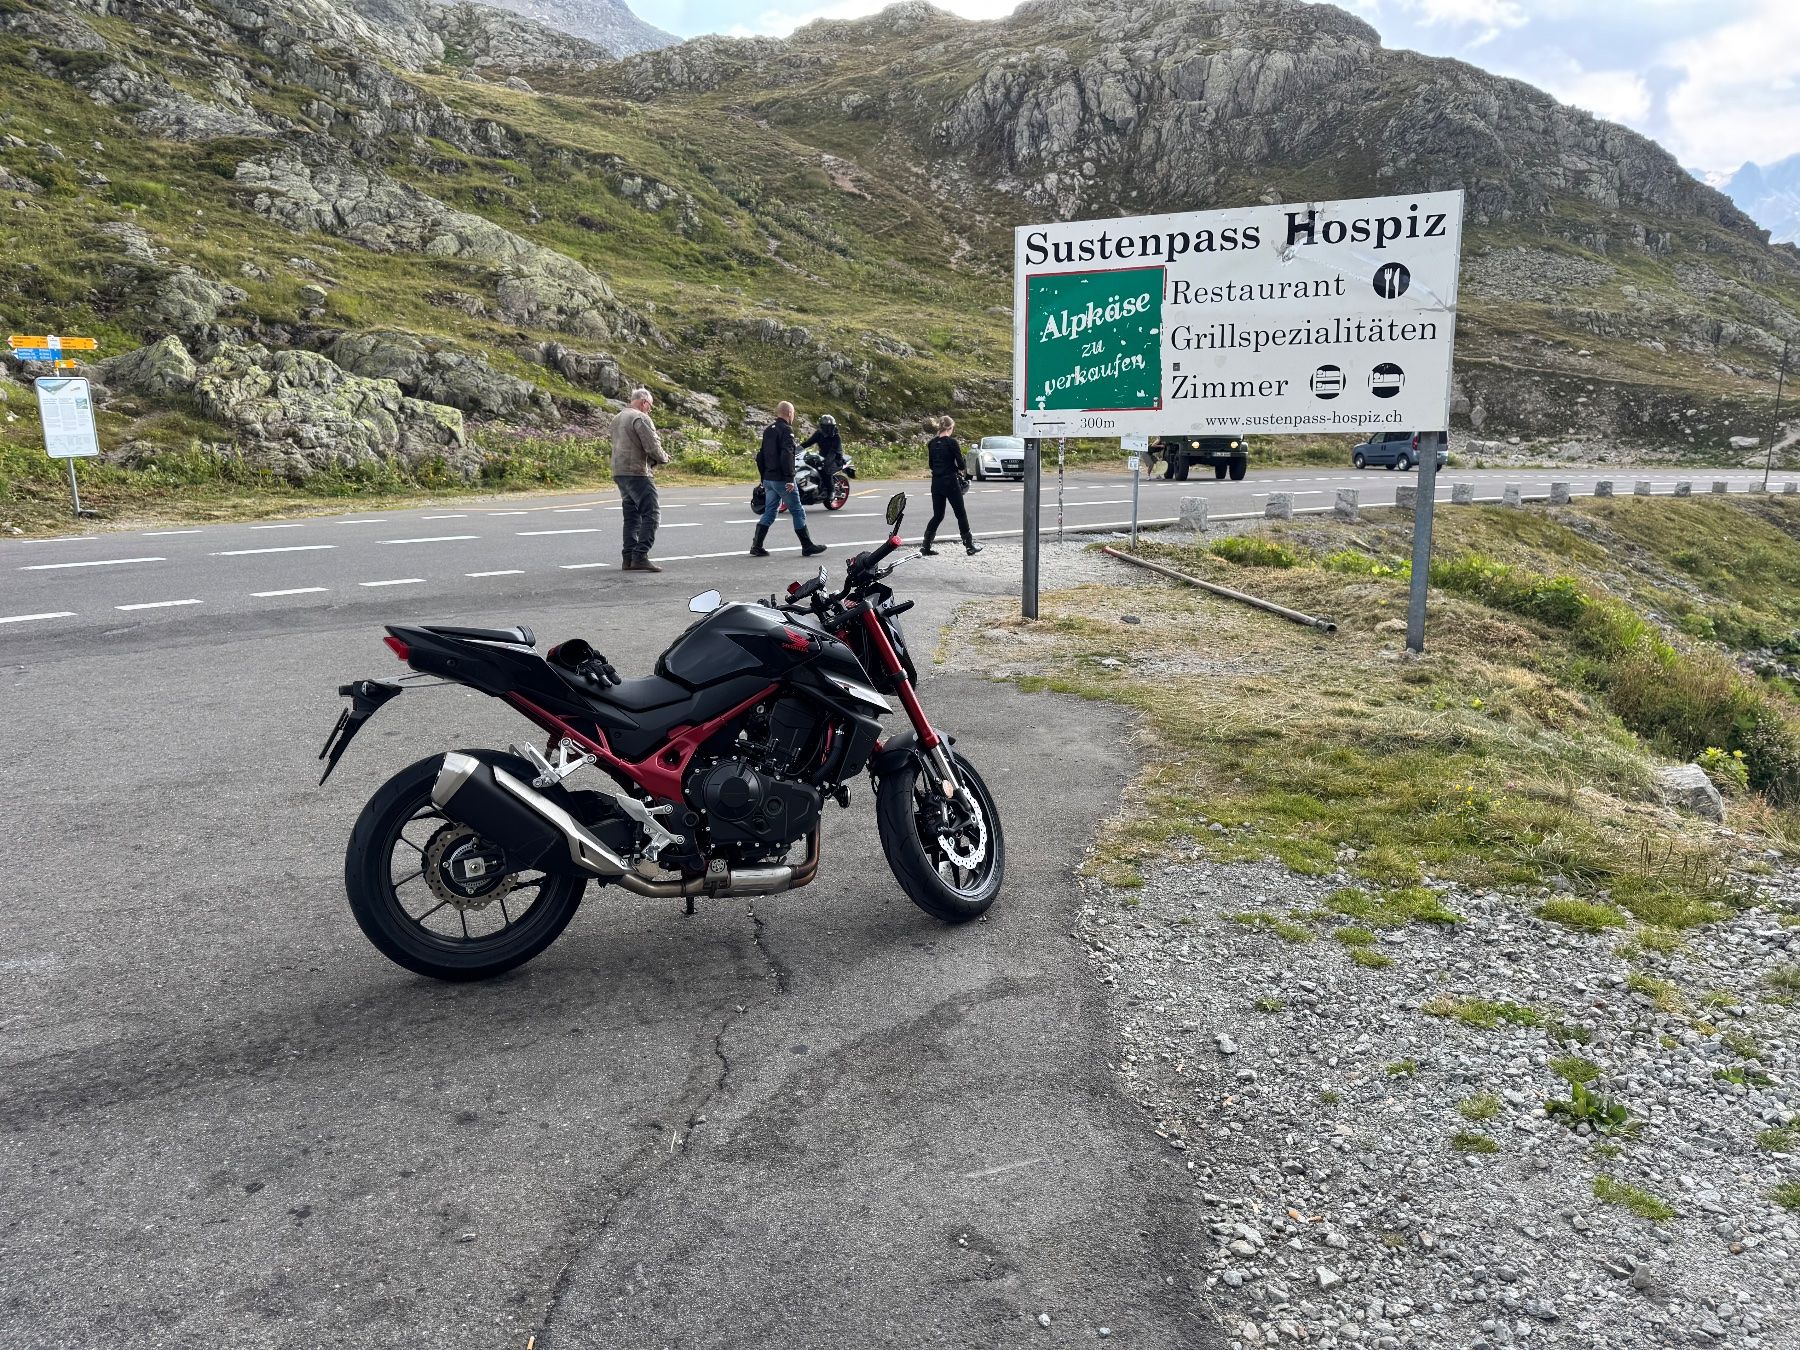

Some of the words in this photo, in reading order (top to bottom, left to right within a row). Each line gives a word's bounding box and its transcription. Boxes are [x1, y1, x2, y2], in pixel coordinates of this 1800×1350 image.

[1025, 225, 1260, 265] Sustenpass
[1284, 203, 1447, 249] Hospiz
[1170, 273, 1346, 305] Restaurant
[1040, 293, 1151, 343] Alpkäse
[1081, 340, 1105, 358] zu
[1170, 317, 1437, 352] Grillspezialitäten
[1044, 353, 1146, 396] verkaufen
[1171, 374, 1289, 399] Zimmer
[1080, 417, 1115, 428] 300m
[1205, 410, 1403, 428] www.sustenpass-hospiz.ch
